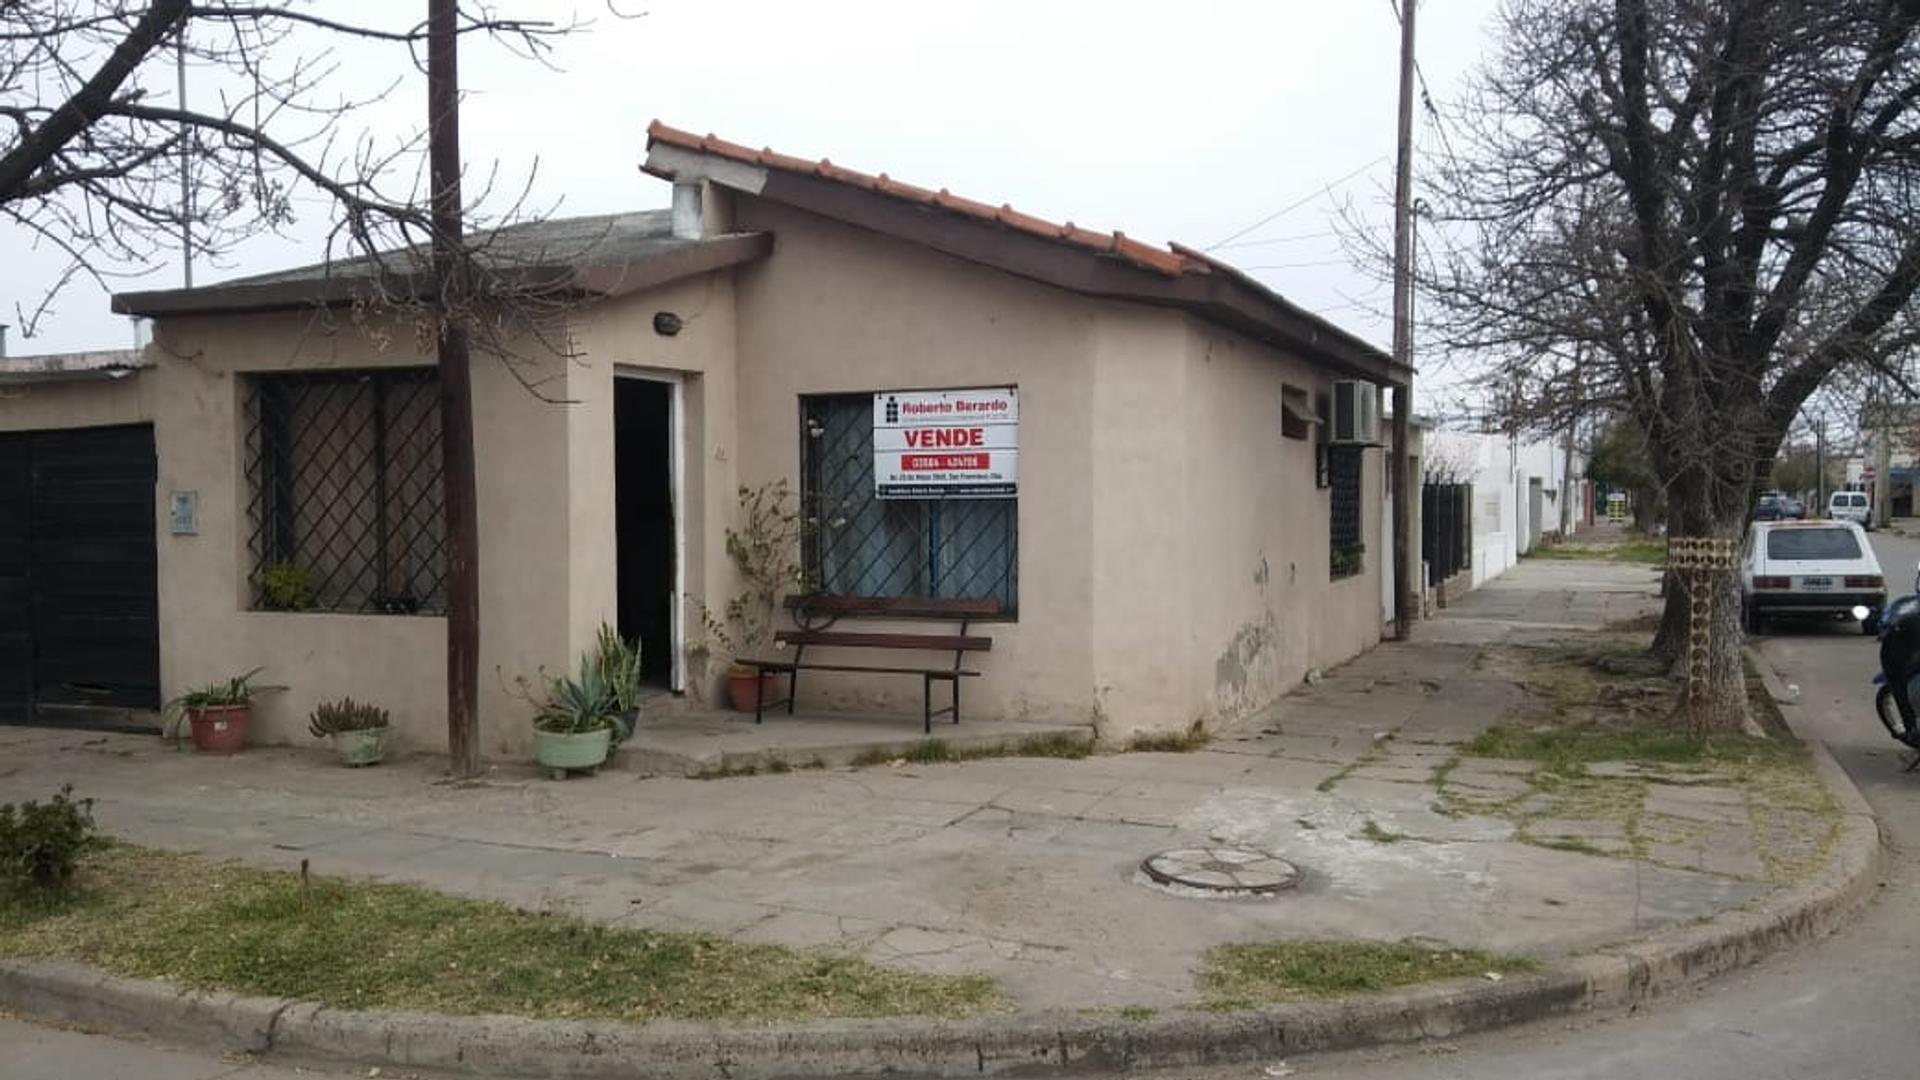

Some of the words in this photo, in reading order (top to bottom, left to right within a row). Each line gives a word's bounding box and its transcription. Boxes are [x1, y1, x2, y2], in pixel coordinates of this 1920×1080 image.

[902, 401, 952, 414] Roberto
[956, 399, 1007, 412] Berardo
[904, 428, 983, 448] VENDE
